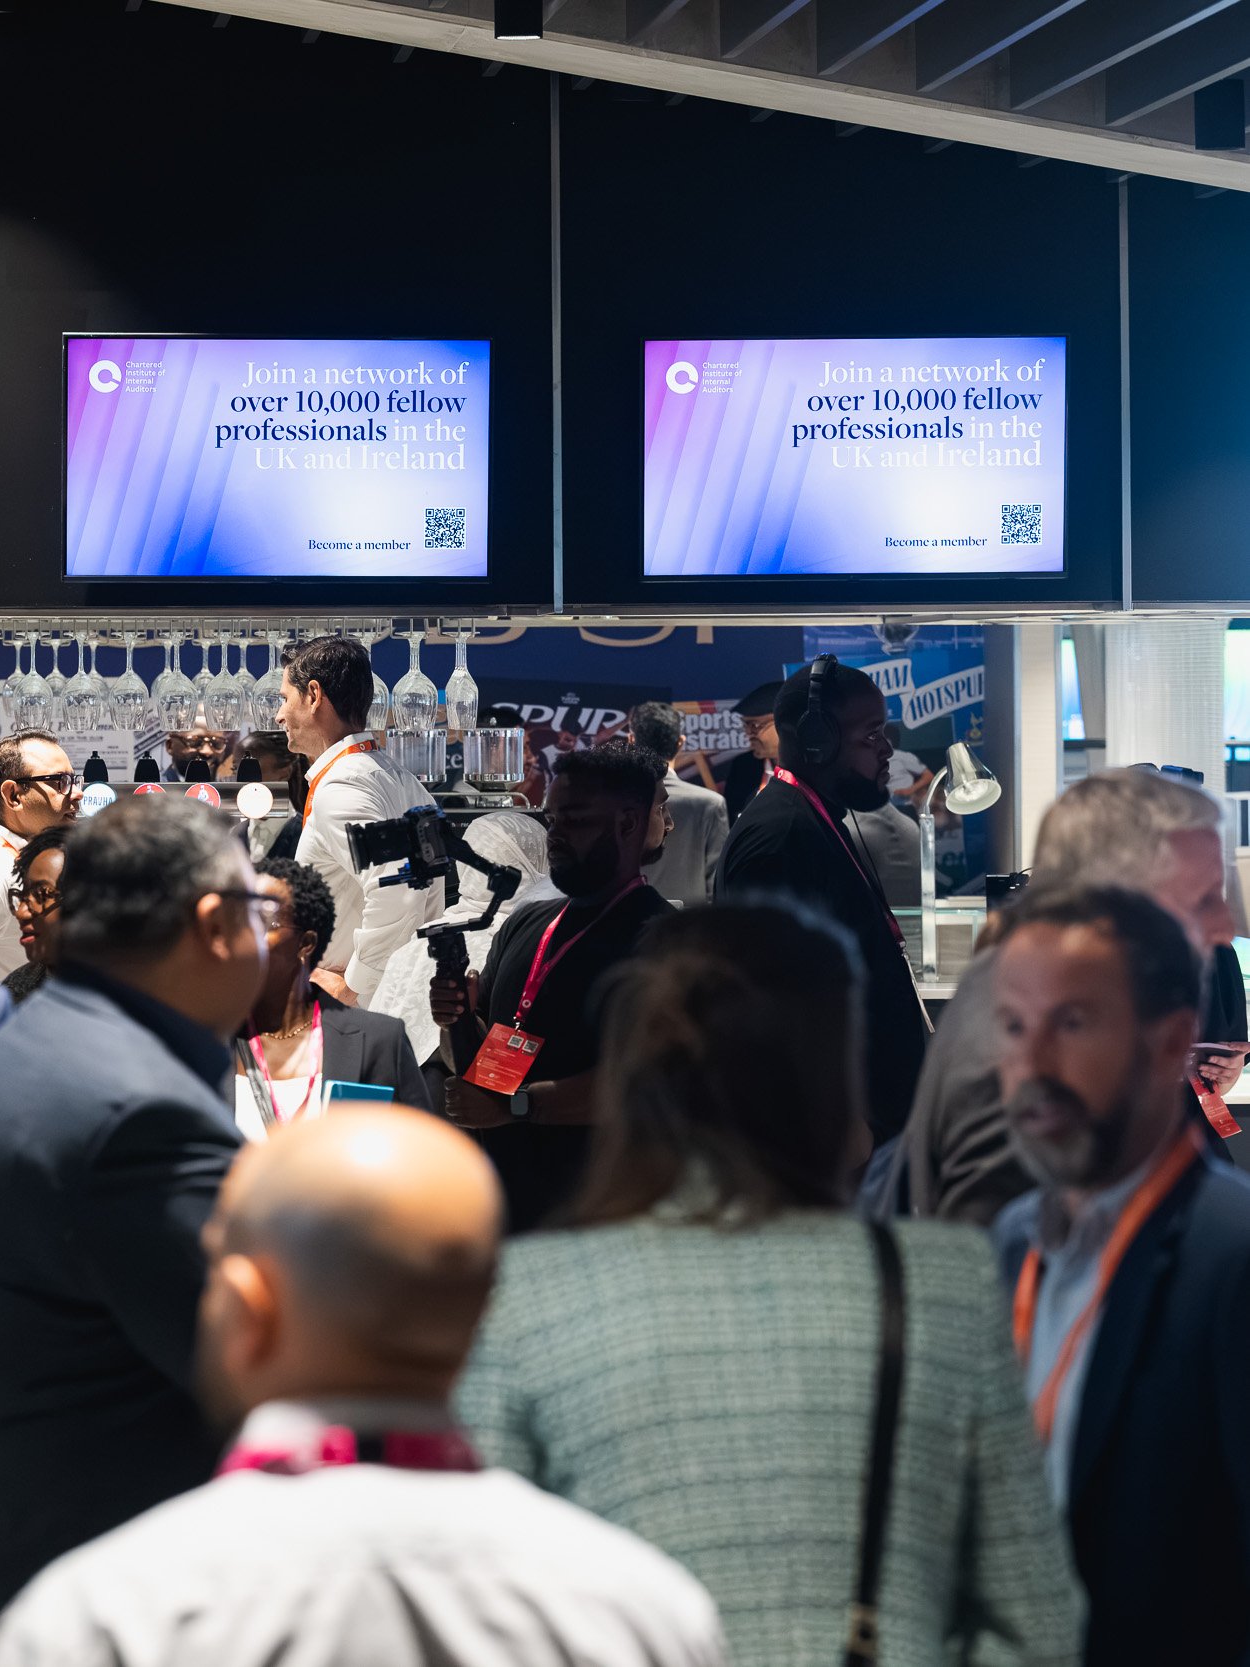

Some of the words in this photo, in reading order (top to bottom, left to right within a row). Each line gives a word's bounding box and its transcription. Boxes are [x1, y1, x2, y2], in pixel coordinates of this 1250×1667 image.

[125, 369, 155, 377] Institute
[157, 369, 166, 377] of
[242, 361, 296, 388] Join
[303, 368, 317, 385] a
[324, 361, 435, 385] network
[440, 361, 470, 385] of
[734, 369, 743, 377] of
[818, 360, 873, 387] Join
[880, 366, 893, 383] a
[901, 359, 1009, 383] network
[1016, 358, 1045, 382] of
[230, 395, 288, 413] over
[295, 390, 380, 416] 10,000
[386, 389, 468, 413] fellow
[807, 394, 865, 412] over
[872, 388, 956, 415] 10,000
[962, 386, 1043, 410] fellow
[214, 417, 387, 448] professionals
[393, 419, 417, 441] in
[424, 418, 466, 441] the
[791, 416, 963, 448] professionals
[969, 416, 993, 439] in
[1000, 415, 1043, 438] the
[254, 447, 297, 470] UK
[303, 447, 350, 470] and
[360, 443, 466, 470] Ireland
[831, 446, 873, 468] UK
[880, 445, 927, 468] and
[936, 440, 1042, 467] Ireland
[308, 539, 353, 550] Become
[355, 542, 361, 550] a
[364, 539, 411, 550] member
[885, 537, 930, 547] Become
[931, 539, 938, 547] a
[941, 535, 988, 546] member
[682, 729, 751, 751] strate
